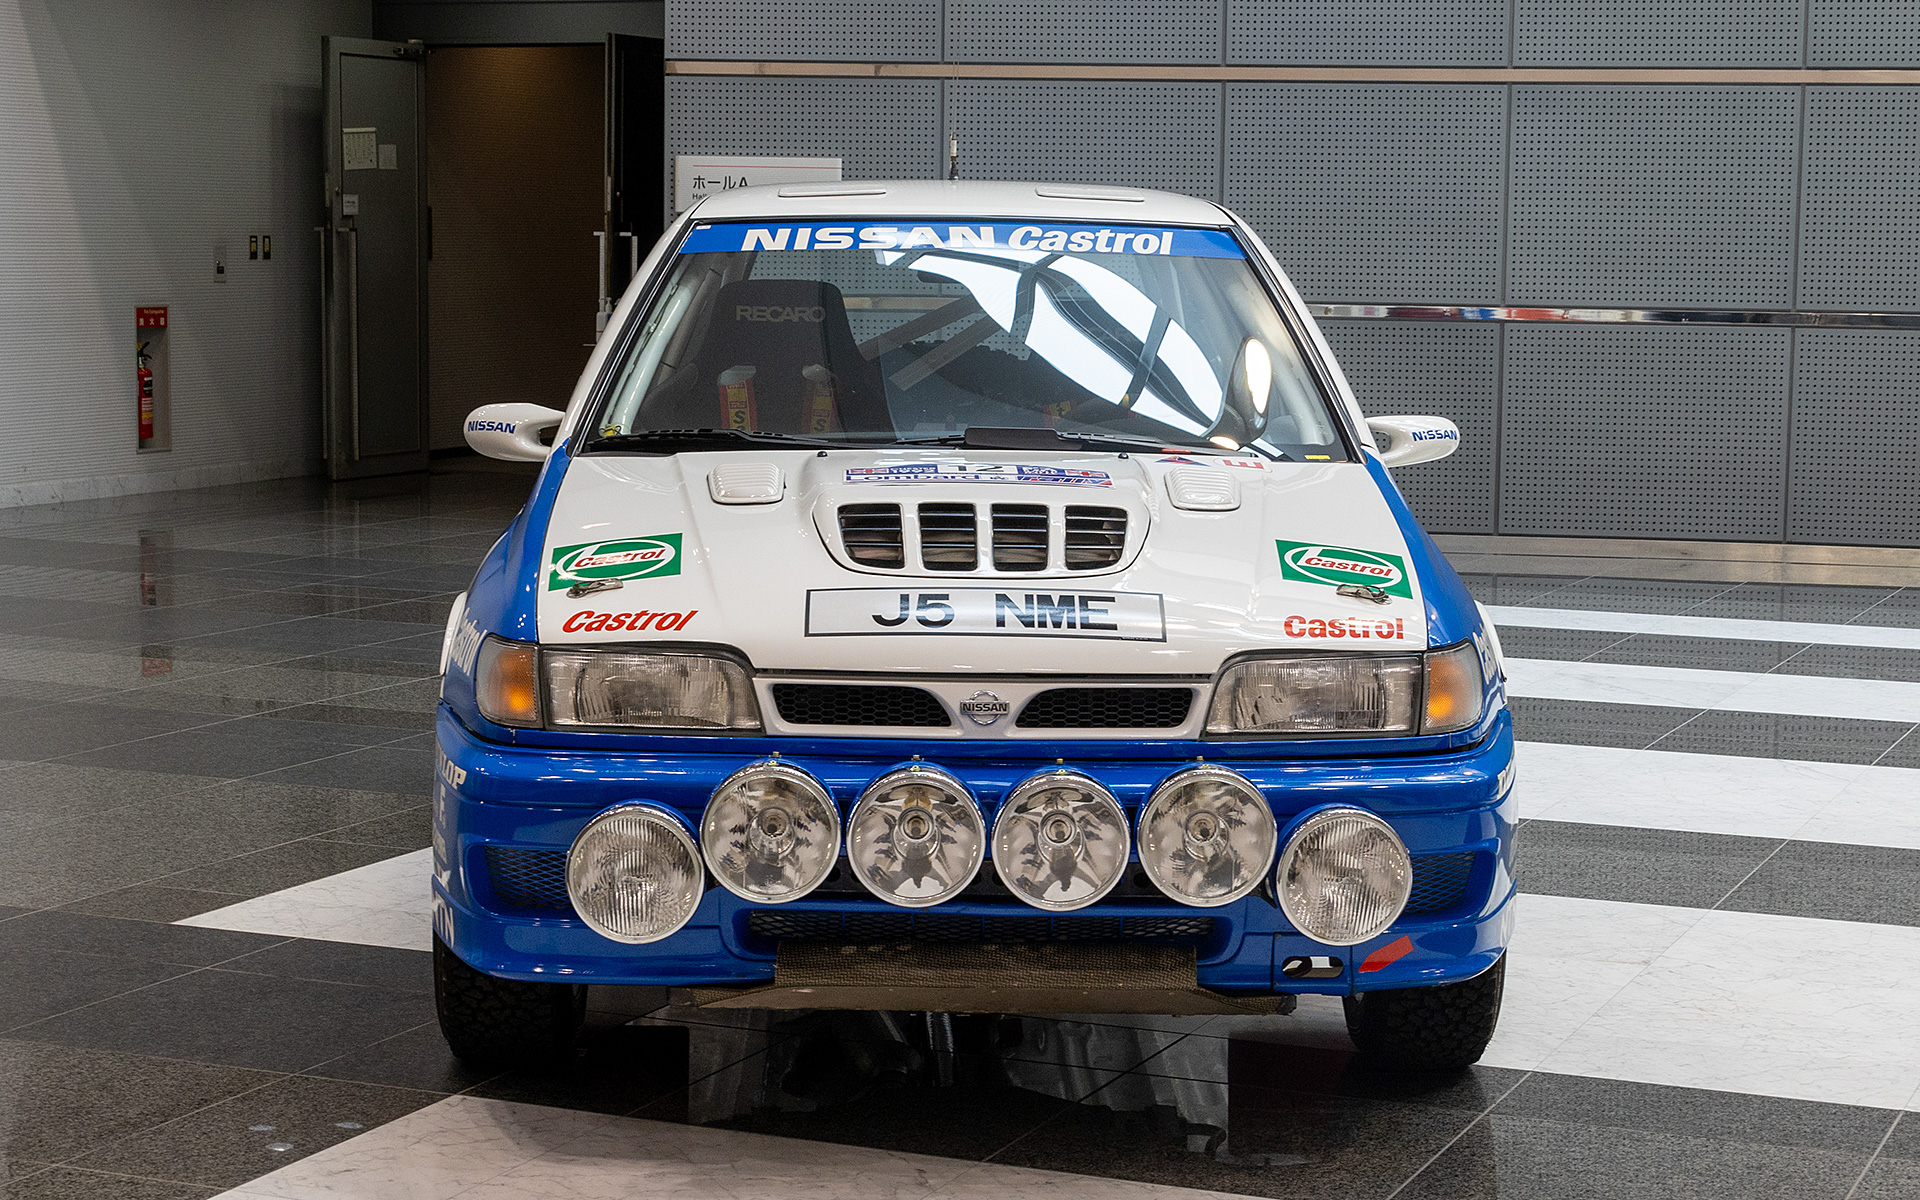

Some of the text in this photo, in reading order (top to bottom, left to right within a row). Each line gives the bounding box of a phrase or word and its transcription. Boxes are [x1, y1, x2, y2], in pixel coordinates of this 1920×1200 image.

[692, 175, 748, 190] ホールA
[741, 226, 1173, 255] NISSAN Castrol
[735, 305, 826, 322] RECARO
[467, 420, 517, 435] NISSAN
[1411, 429, 1458, 442] NISSAN
[846, 473, 980, 481] Lombard
[946, 464, 1005, 473] 12
[574, 548, 667, 568] Castrol
[1304, 556, 1393, 577] Castrol
[871, 593, 1119, 631] J5 NME
[562, 609, 700, 634] Castrol
[1283, 614, 1405, 640] Castrol
[962, 703, 1008, 712] NISSAN
